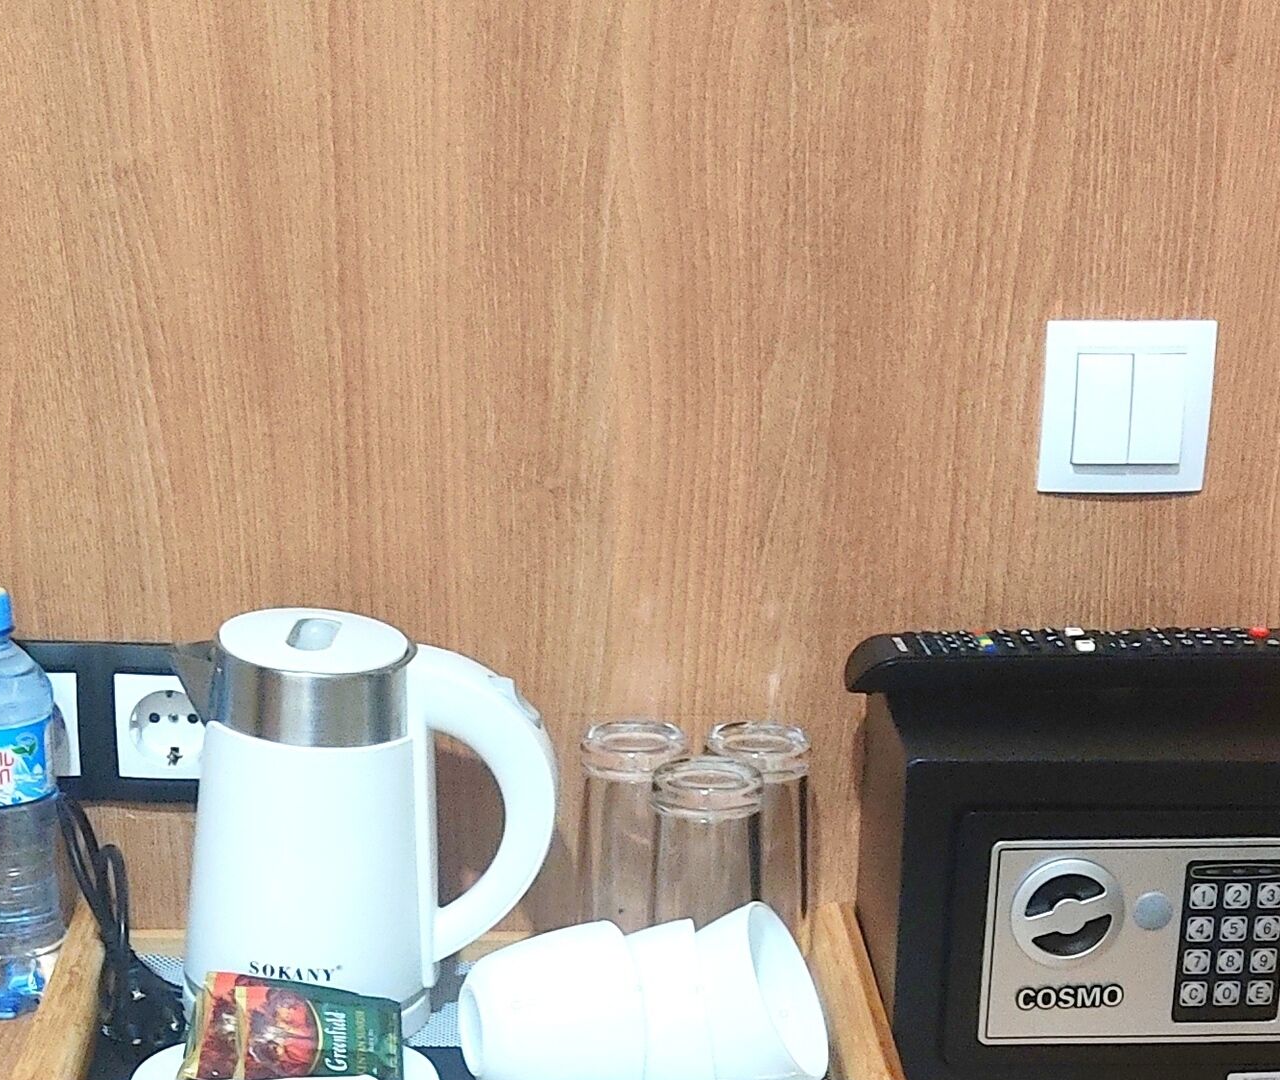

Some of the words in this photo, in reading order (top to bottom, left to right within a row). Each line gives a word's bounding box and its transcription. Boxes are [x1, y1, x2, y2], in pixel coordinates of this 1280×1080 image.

[1232, 889, 1242, 903] 2
[1266, 888, 1276, 902] 3
[1195, 923, 1205, 936] 4
[1229, 922, 1238, 935] 5
[1263, 922, 1271, 935] 6
[1193, 955, 1202, 969] 7
[1225, 954, 1235, 968] 8
[1259, 954, 1268, 968] 9
[249, 960, 335, 982] SOKANY
[1016, 984, 1124, 1010] COSMO
[1188, 987, 1199, 1001] C
[1255, 986, 1264, 999] E
[323, 1010, 349, 1072] Greenfield
